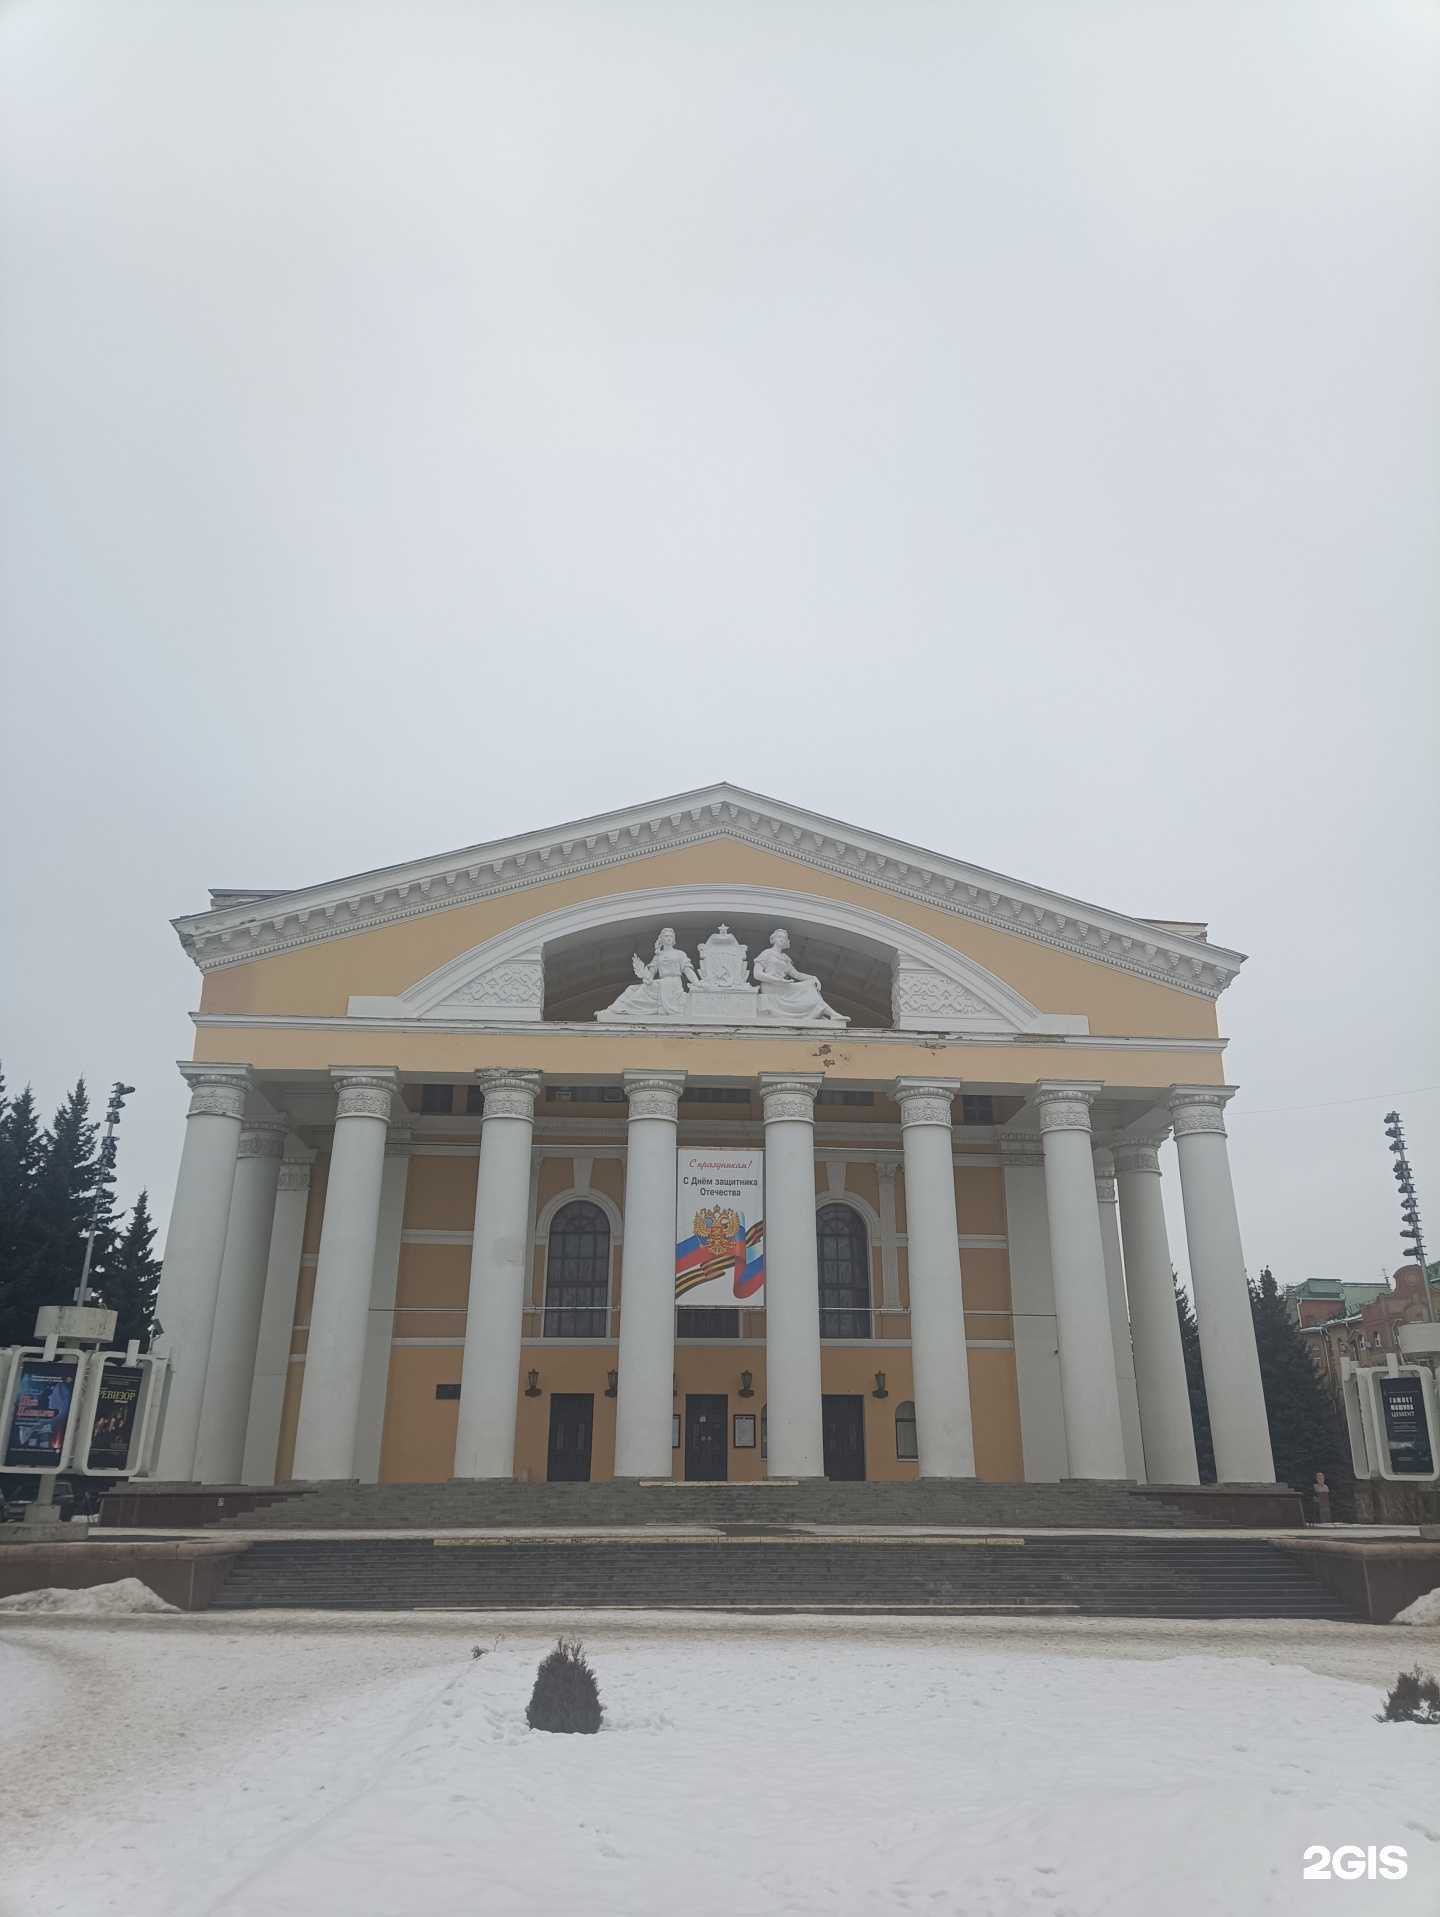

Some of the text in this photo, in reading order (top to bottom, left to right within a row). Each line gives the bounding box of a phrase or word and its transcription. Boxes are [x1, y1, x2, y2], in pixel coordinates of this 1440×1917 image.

[689, 1159, 752, 1171] С праздником!
[683, 1176, 689, 1185] С
[691, 1176, 713, 1186] Днём
[700, 1187, 741, 1197] Отечества
